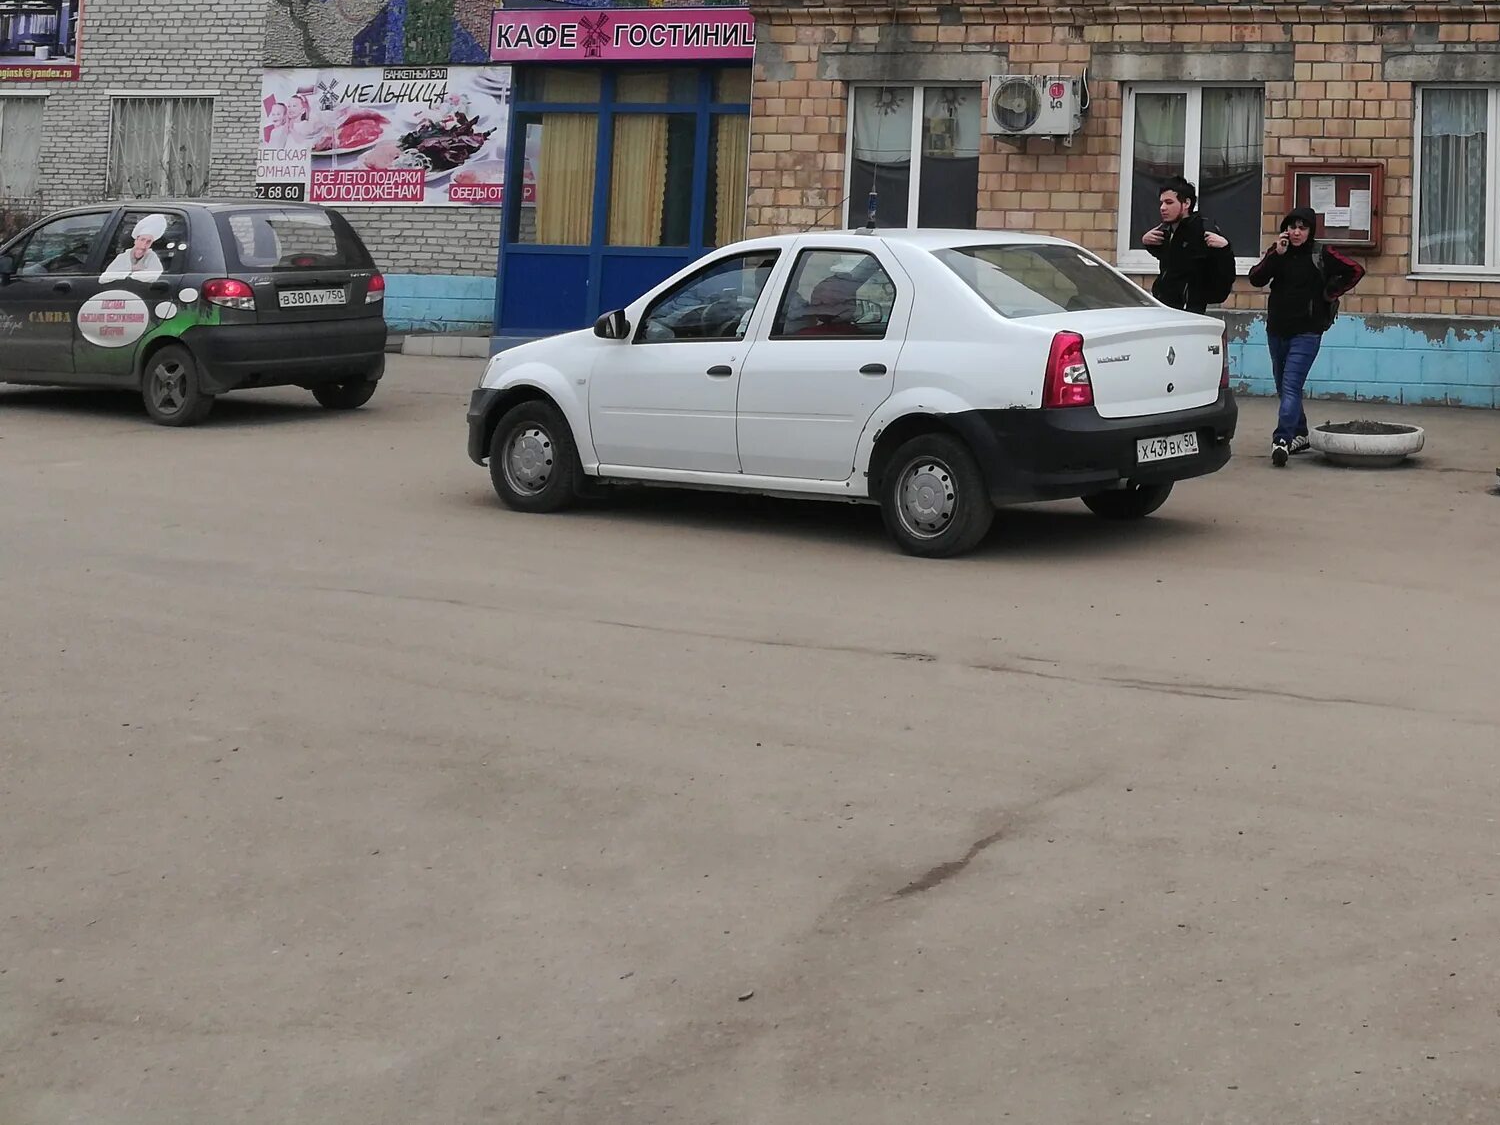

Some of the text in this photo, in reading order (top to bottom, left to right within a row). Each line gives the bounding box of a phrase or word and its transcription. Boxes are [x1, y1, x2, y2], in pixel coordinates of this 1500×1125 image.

[496, 23, 578, 50] КАФЕ
[431, 68, 447, 79] ЗАЛ
[340, 81, 449, 110] МЕЛЬНИЦА
[337, 171, 367, 184] ЛЕТО
[369, 171, 421, 186] ПОДАРКИ
[268, 186, 282, 199] 68
[284, 186, 300, 199] 60
[313, 184, 421, 201] МОЛОДОЖЕНАМ
[450, 186, 488, 201] ОБЕДЫ
[488, 186, 504, 199] ОТ
